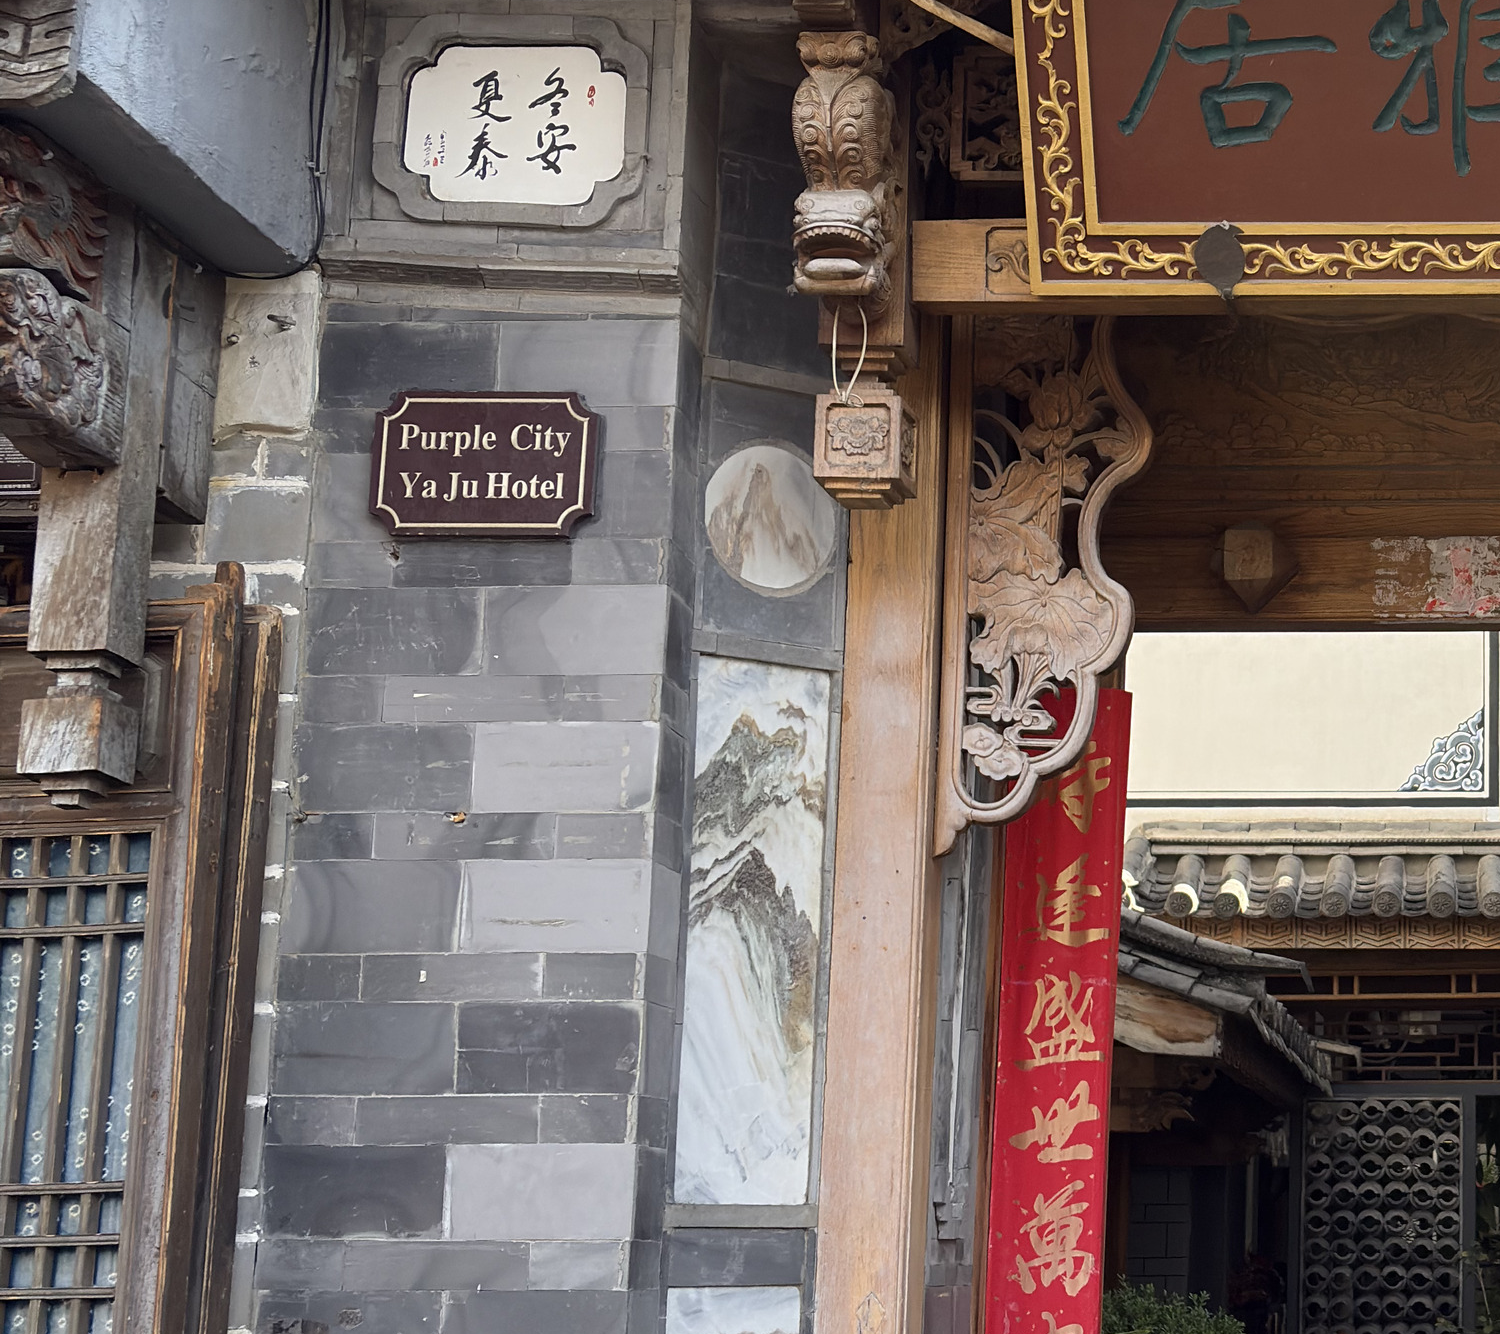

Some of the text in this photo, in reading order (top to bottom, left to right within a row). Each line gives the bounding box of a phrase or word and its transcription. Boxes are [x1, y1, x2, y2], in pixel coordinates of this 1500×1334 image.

[398, 423, 572, 457] Purple City
[399, 472, 564, 502] Ya Ju Hotel
